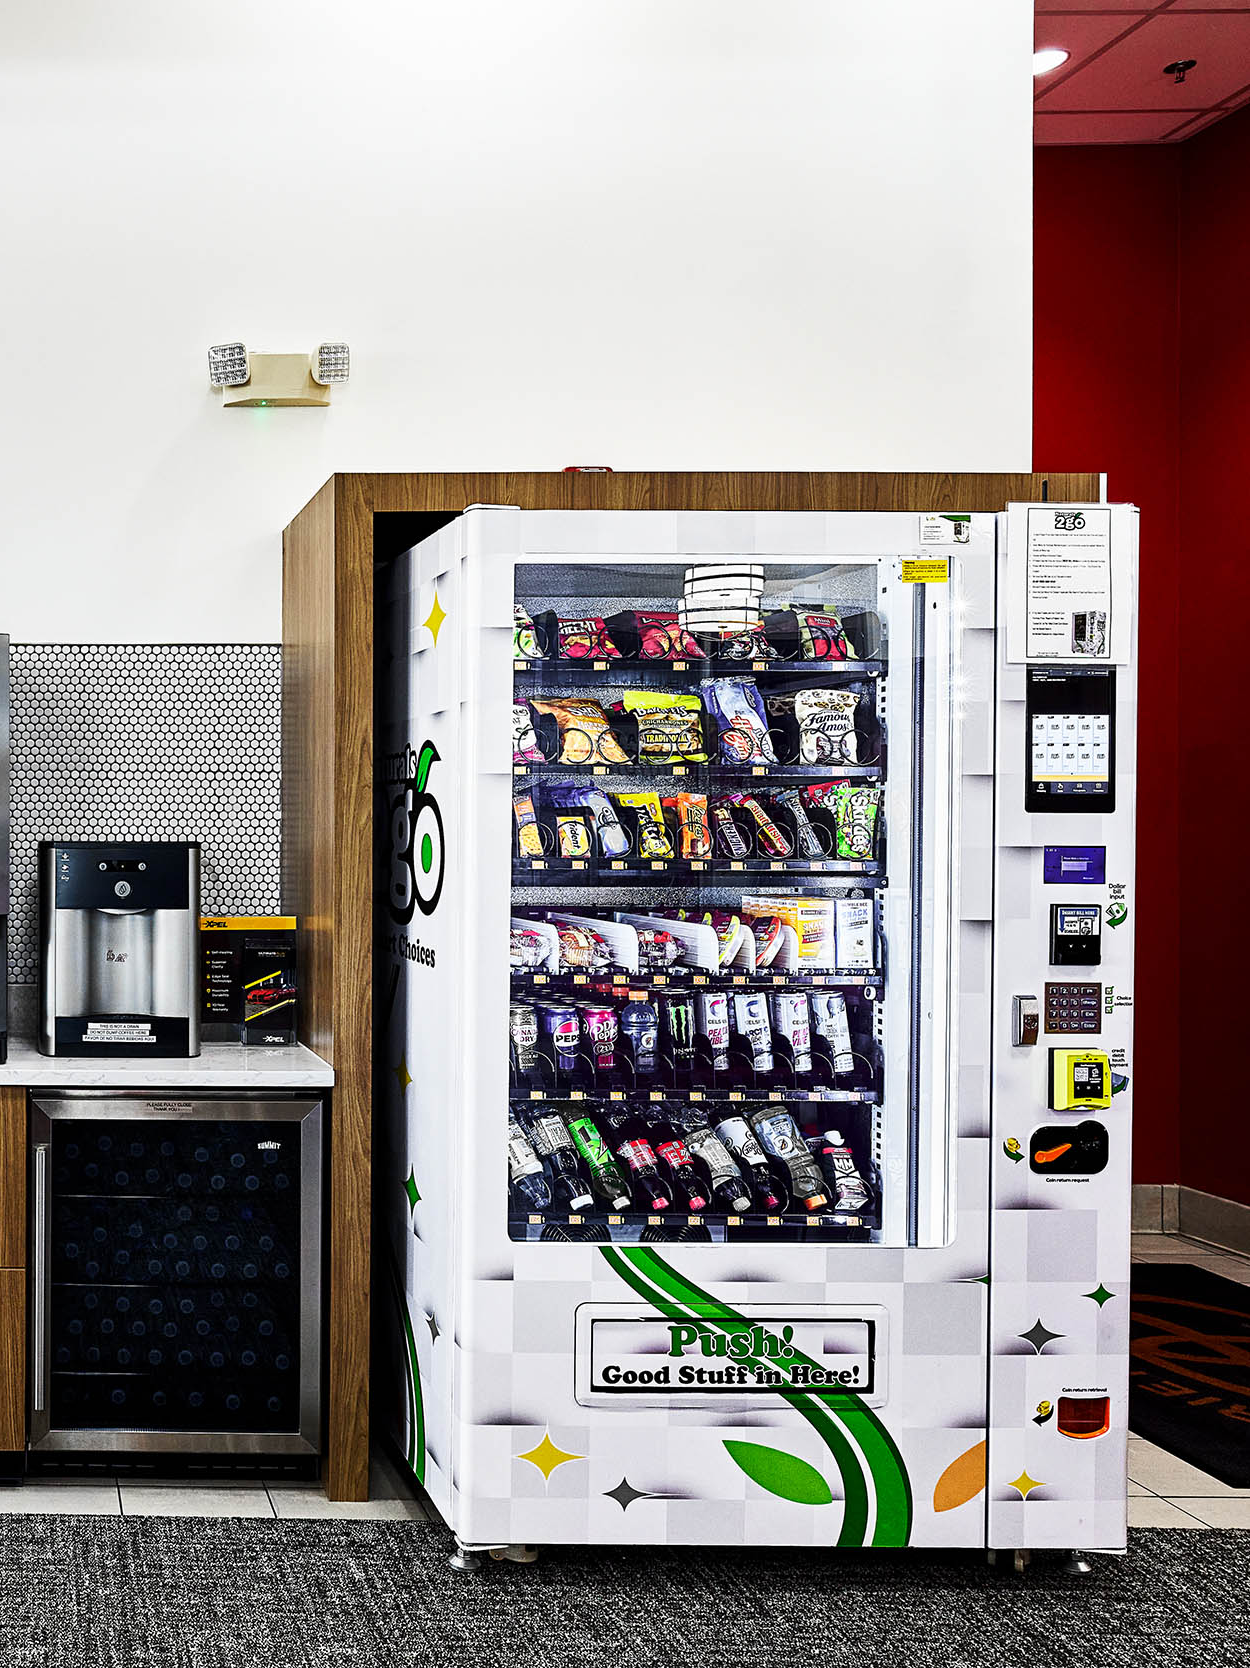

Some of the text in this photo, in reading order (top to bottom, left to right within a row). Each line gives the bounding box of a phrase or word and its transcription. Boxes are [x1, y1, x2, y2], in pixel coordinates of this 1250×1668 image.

[203, 920, 228, 928] XPEL
[263, 1035, 284, 1043] XPEL
[555, 1035, 581, 1043] PEPS
[257, 1141, 281, 1150] SUMMIT
[668, 1324, 795, 1358] Push!
[601, 1365, 861, 1385] Good Stuff in Here!
